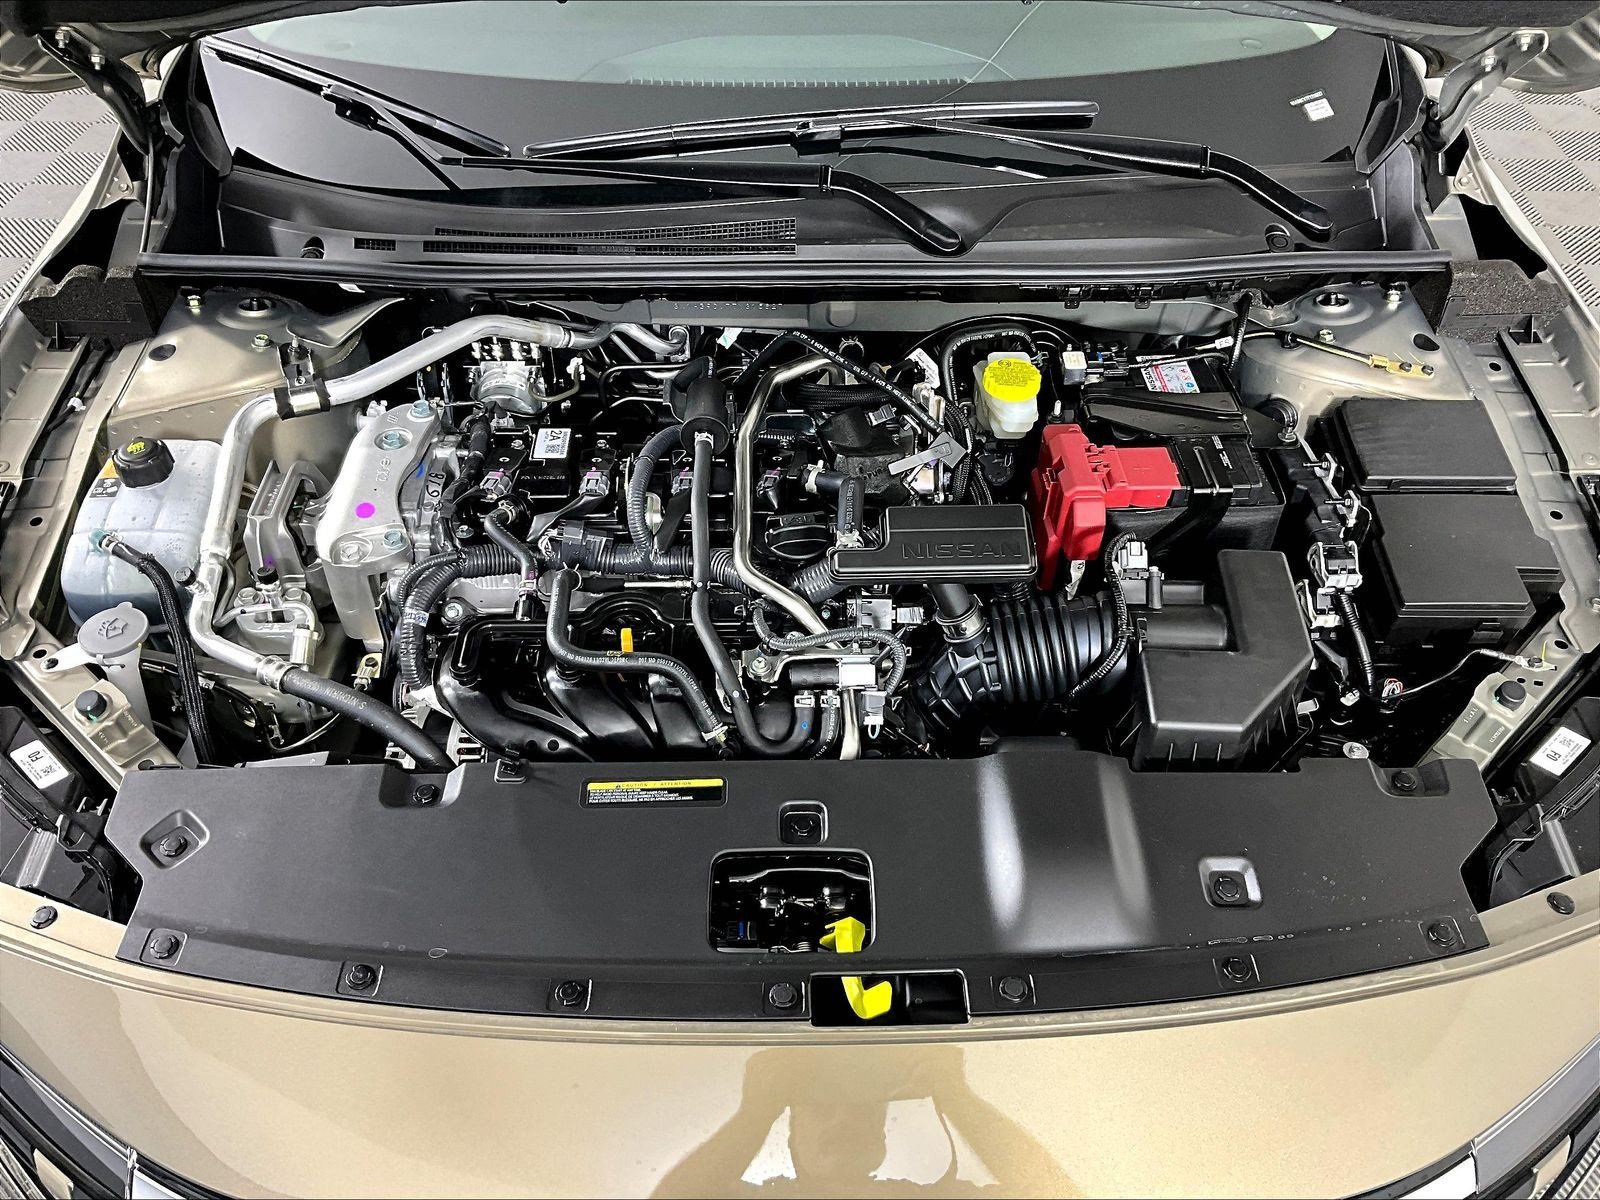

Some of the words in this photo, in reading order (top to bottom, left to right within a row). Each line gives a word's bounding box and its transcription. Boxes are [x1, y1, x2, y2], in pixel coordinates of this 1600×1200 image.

[1143, 365, 1158, 391] NISSAN
[549, 430, 562, 442] 2A
[902, 543, 1023, 560] NISSAN
